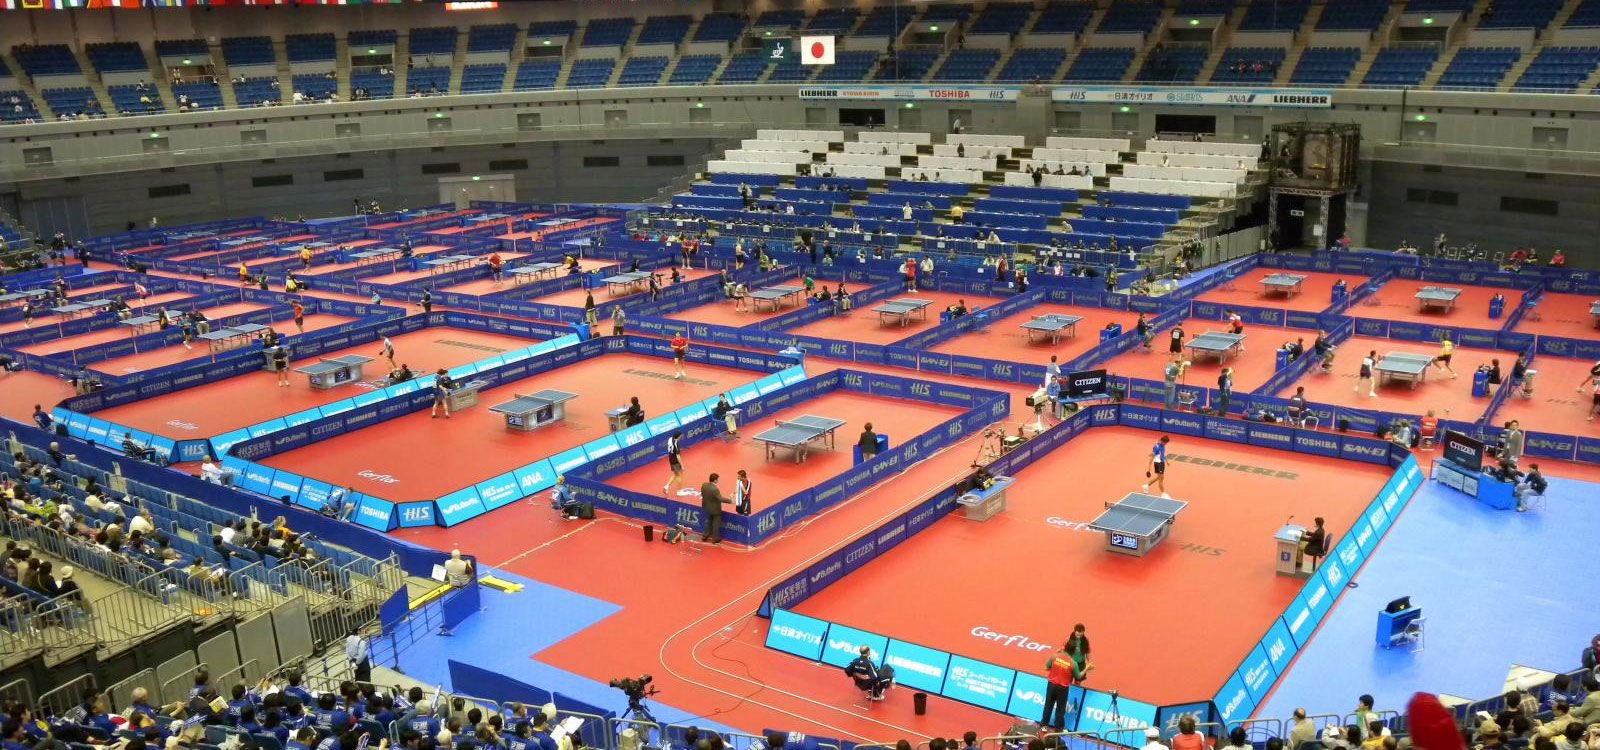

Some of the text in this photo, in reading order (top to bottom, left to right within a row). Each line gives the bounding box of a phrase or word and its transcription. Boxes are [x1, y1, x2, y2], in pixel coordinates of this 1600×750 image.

[990, 90, 1004, 98] HIS
[1070, 91, 1086, 99] HIS
[1226, 94, 1246, 102] ANA
[1274, 95, 1327, 104] LIEBHERR
[1107, 296, 1122, 306] HIS
[355, 305, 365, 314] HIS
[543, 307, 555, 317] HIS
[1260, 310, 1278, 321] HIS
[430, 315, 445, 323] HIS
[693, 326, 708, 336] HIS
[607, 340, 625, 348] HIS
[830, 344, 847, 354] HIS
[738, 357, 764, 366] TOSHIBA
[890, 353, 916, 362] TOSHIBA
[921, 357, 948, 366] SAN-EI
[992, 364, 1012, 375] HIS
[816, 377, 837, 389] SAN-EI
[844, 374, 862, 385] HIS
[1075, 377, 1101, 387] CITIZEN
[141, 381, 169, 393] CITIZEN
[910, 383, 930, 395] HIS
[747, 402, 762, 417] HIS
[992, 399, 1005, 415] HIS
[347, 411, 377, 425] LIEBHERR
[1094, 408, 1116, 420] HIS
[1128, 412, 1158, 422] 日清オイリオ
[313, 420, 343, 435] CITIZEN
[948, 420, 962, 437] HIS
[1174, 418, 1200, 429] Butterfly
[625, 431, 644, 445] HIS
[1250, 431, 1290, 442] LIEBHERR
[1297, 437, 1337, 449] TOSHIBA
[1449, 440, 1475, 455] CITIZEN
[1527, 439, 1572, 451] SAN-EI
[182, 444, 204, 455] HIS
[904, 443, 918, 461] HIS
[1343, 444, 1386, 457] SAN-EI
[872, 456, 897, 474] SAN-EI
[358, 471, 400, 484] Gerflor
[521, 472, 543, 488] ANA
[846, 470, 871, 488] TOSHIBA
[597, 492, 628, 507] SAN-EI
[361, 506, 388, 520] TOSHIBA
[403, 507, 429, 519] HIS
[676, 508, 700, 523] HIS
[784, 501, 802, 518] ANA
[757, 511, 775, 533] HIS
[846, 541, 874, 564] CITIZEN
[971, 626, 1052, 652] Gerflor
[1270, 639, 1286, 664] ANA
[953, 666, 968, 678] HIS
[1086, 706, 1148, 730] TOSHIBA
